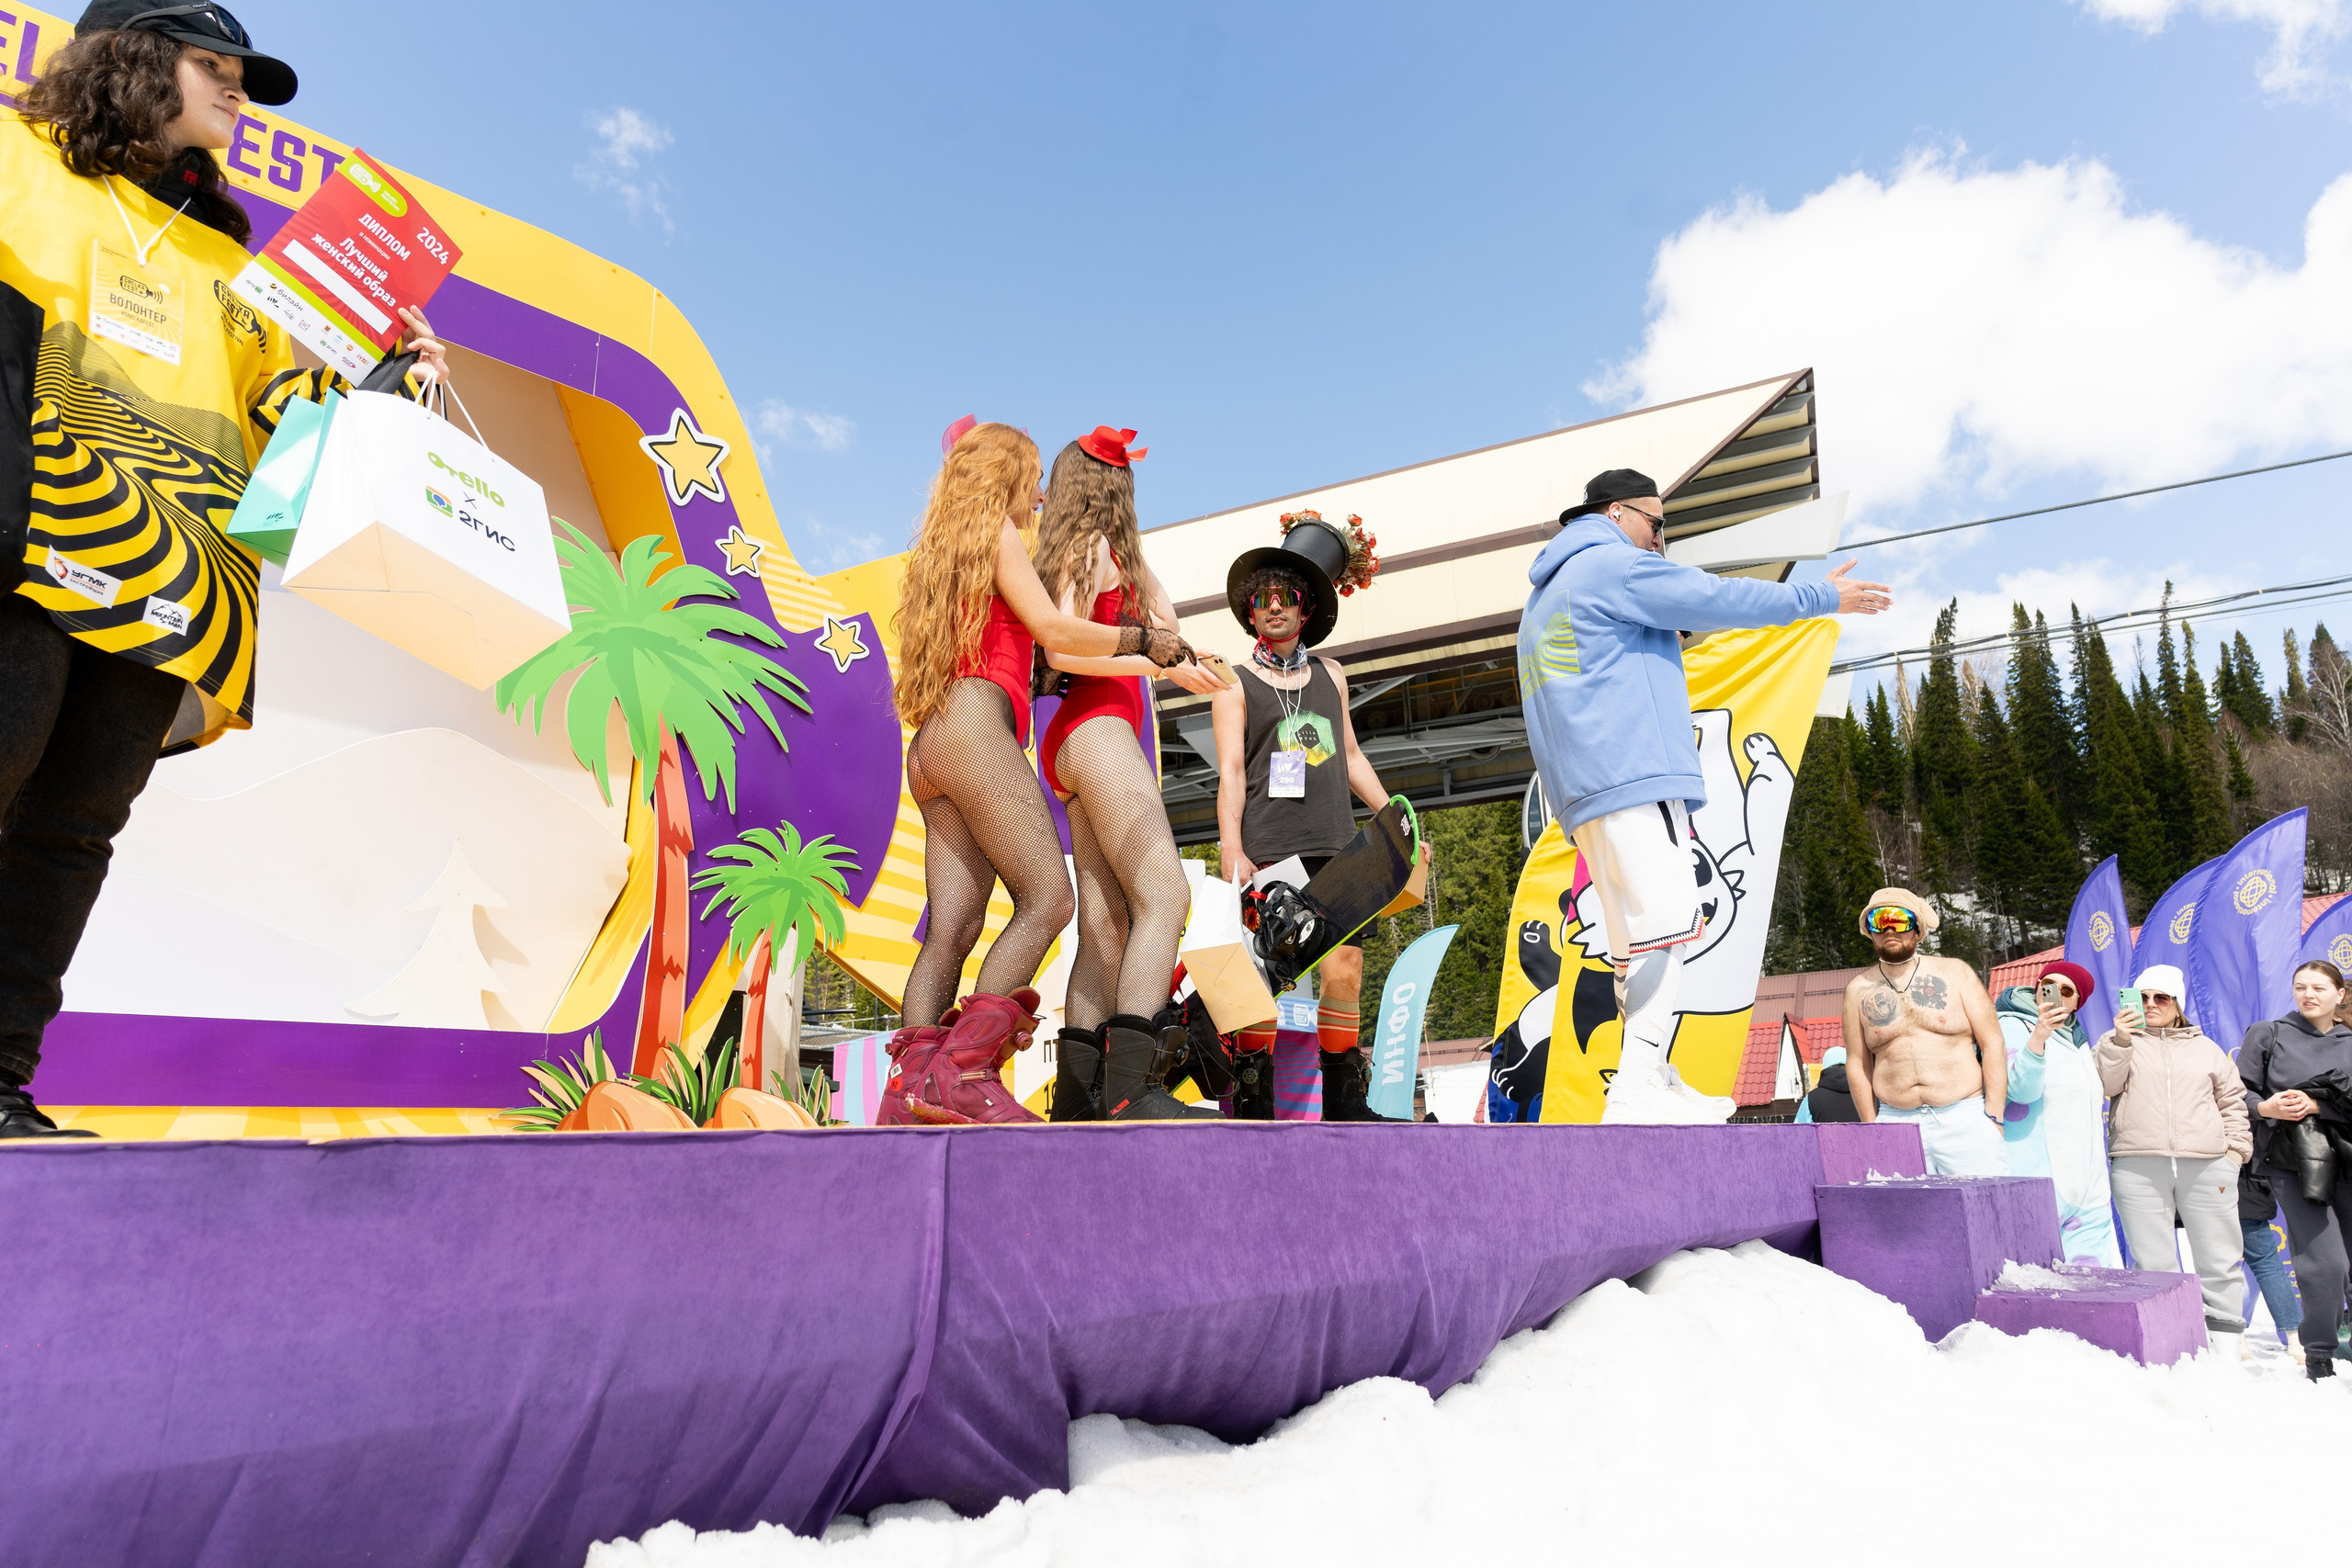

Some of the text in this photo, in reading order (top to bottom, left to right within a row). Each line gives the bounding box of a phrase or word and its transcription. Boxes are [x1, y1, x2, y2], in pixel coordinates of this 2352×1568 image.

[227, 112, 345, 192] EST
[358, 213, 411, 261] ДИПЛОМ
[416, 227, 449, 265] 2024
[311, 233, 396, 307] женский образ
[340, 237, 388, 282] Лучший
[124, 283, 138, 293] FEST
[277, 289, 303, 311] билайн
[109, 293, 167, 323] ВОЛОНТЕР
[458, 510, 515, 552] 2ГИС
[70, 579, 104, 595] ЗАСТРОЙЩИК
[72, 570, 107, 589] УГМК
[151, 611, 183, 625] MOUNTAIN
[168, 621, 183, 629] MAN
[2237, 869, 2277, 894] international
[1382, 982, 1416, 1085] ИНФО
[1110, 1099, 1130, 1116] SALOMON
